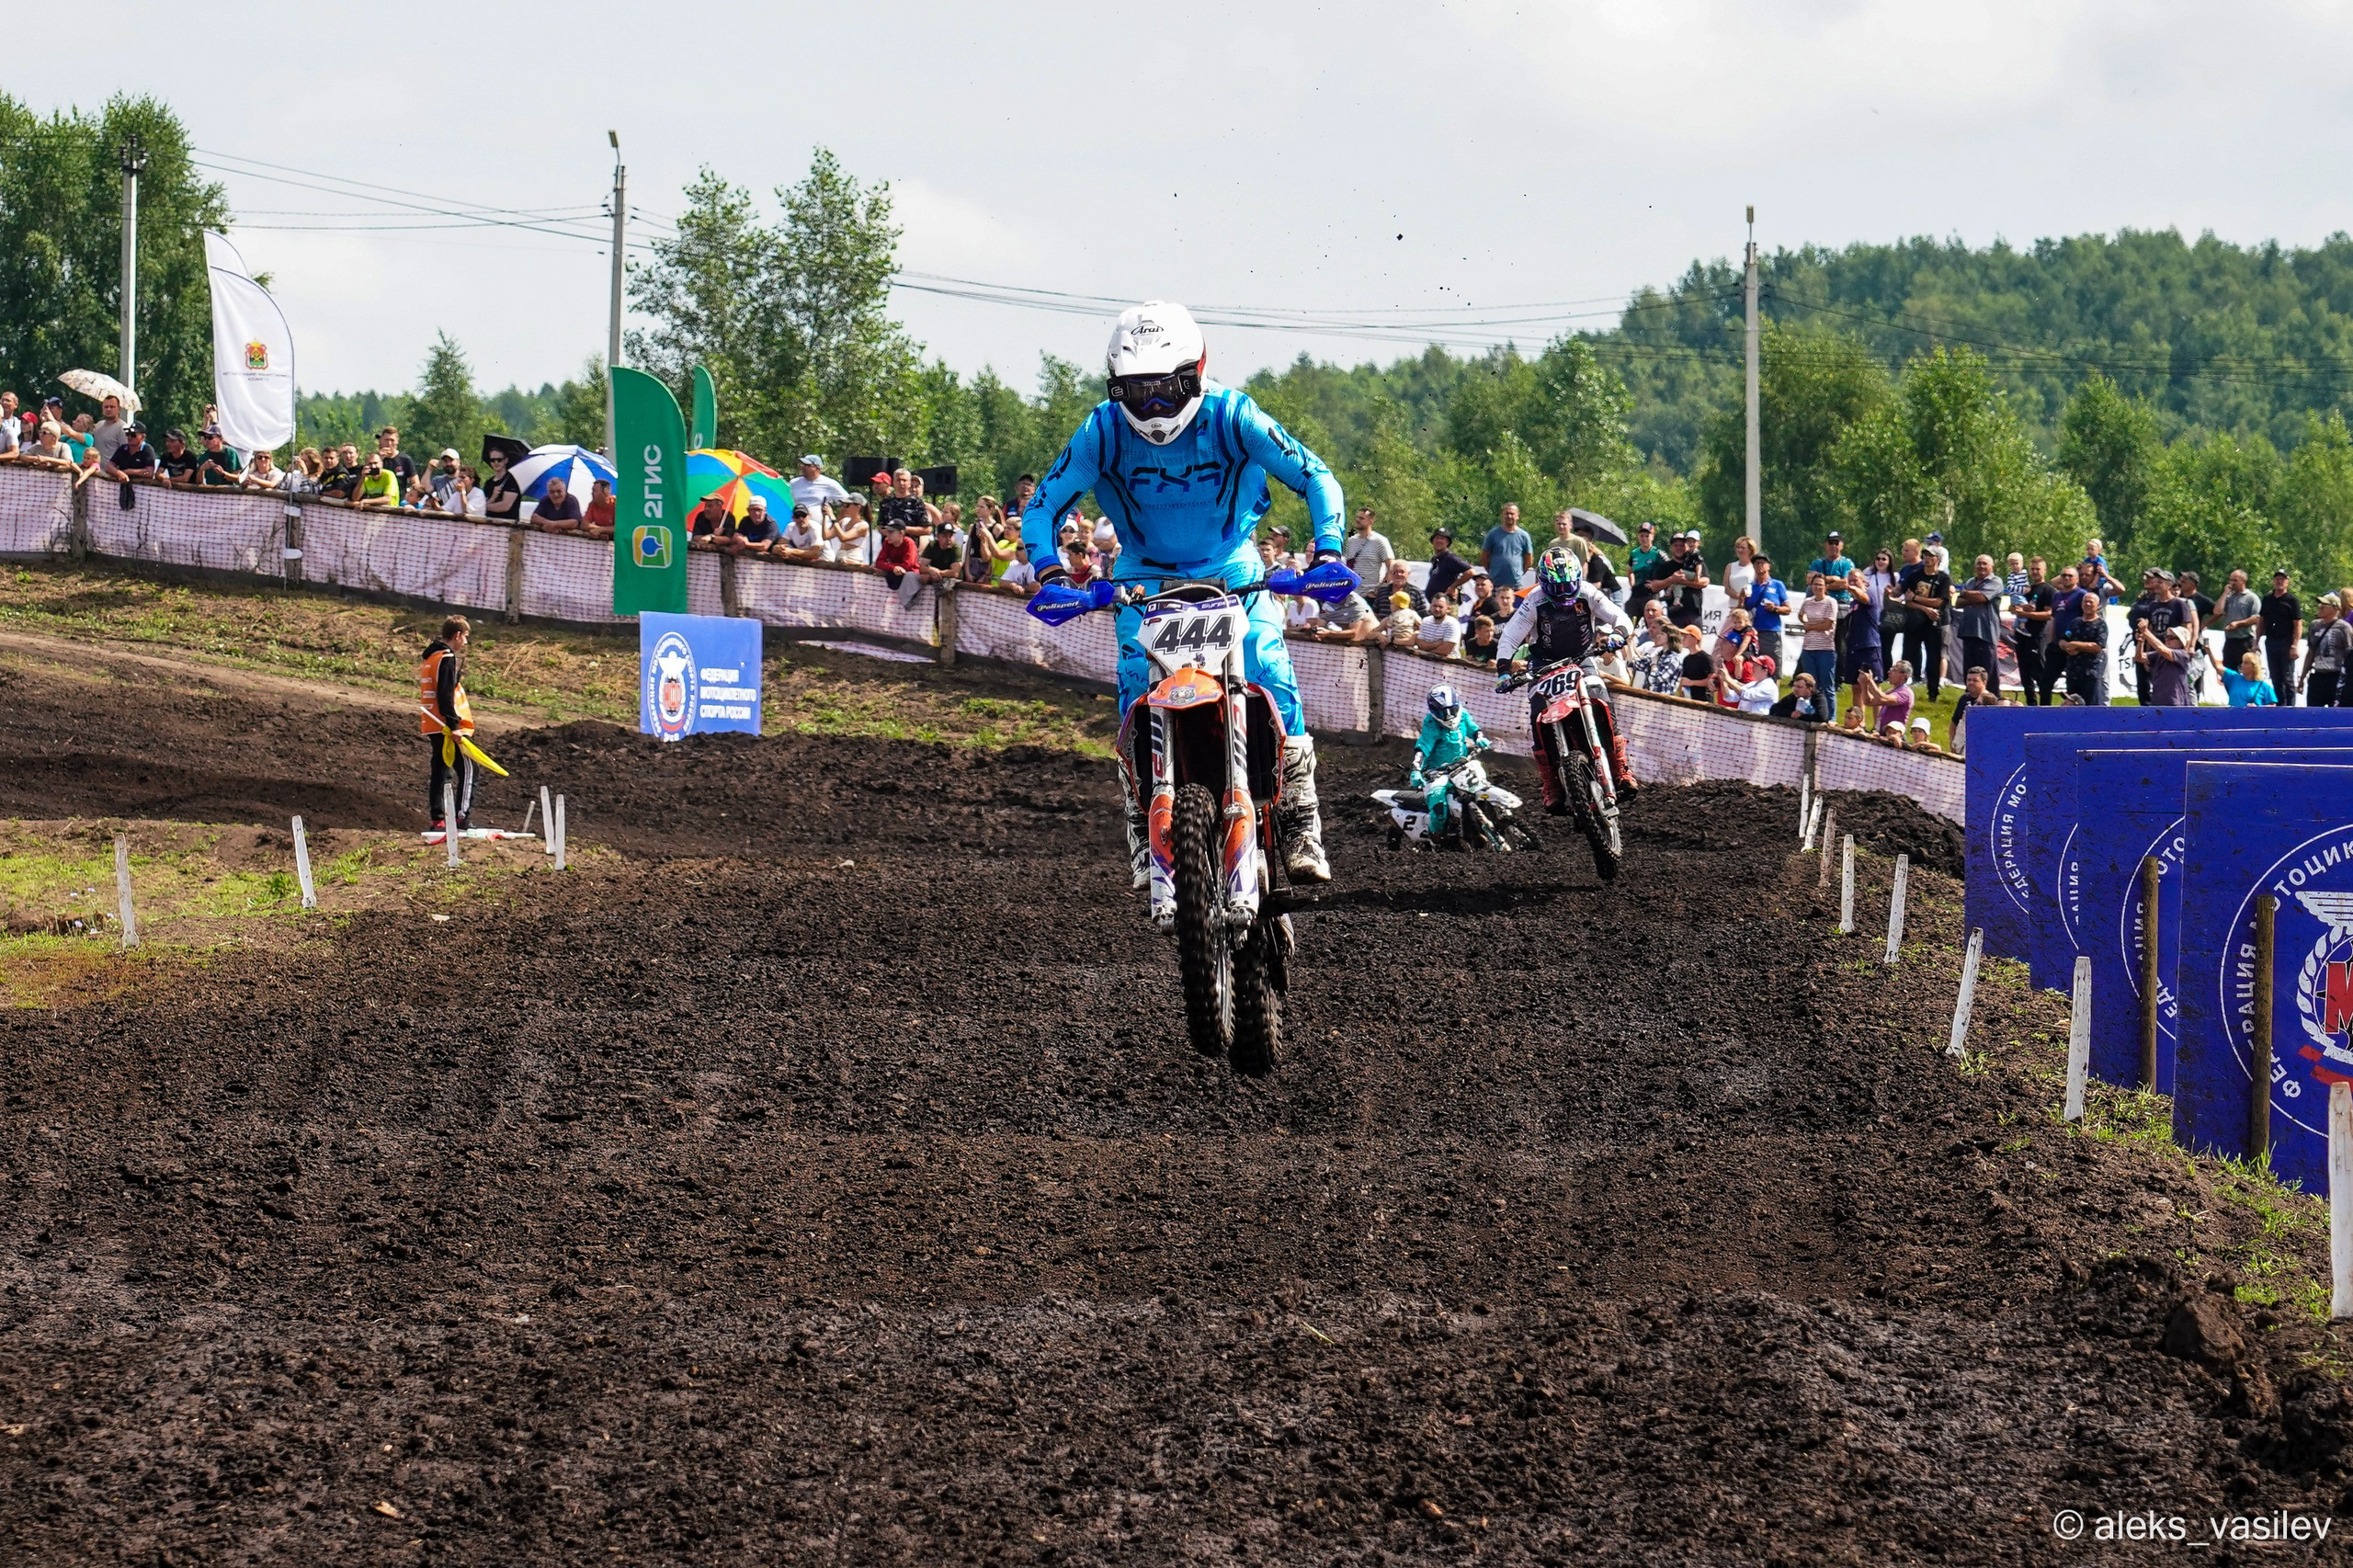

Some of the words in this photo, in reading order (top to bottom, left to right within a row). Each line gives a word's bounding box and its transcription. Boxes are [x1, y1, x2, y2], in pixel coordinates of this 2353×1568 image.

[1131, 325, 1165, 335] Arai
[643, 444, 663, 518] 2ГИС
[1129, 460, 1222, 494] FXR
[1305, 580, 1348, 589] Polisport
[1037, 599, 1080, 612] Polisport
[1152, 614, 1235, 654] 444
[1539, 670, 1582, 699] 269
